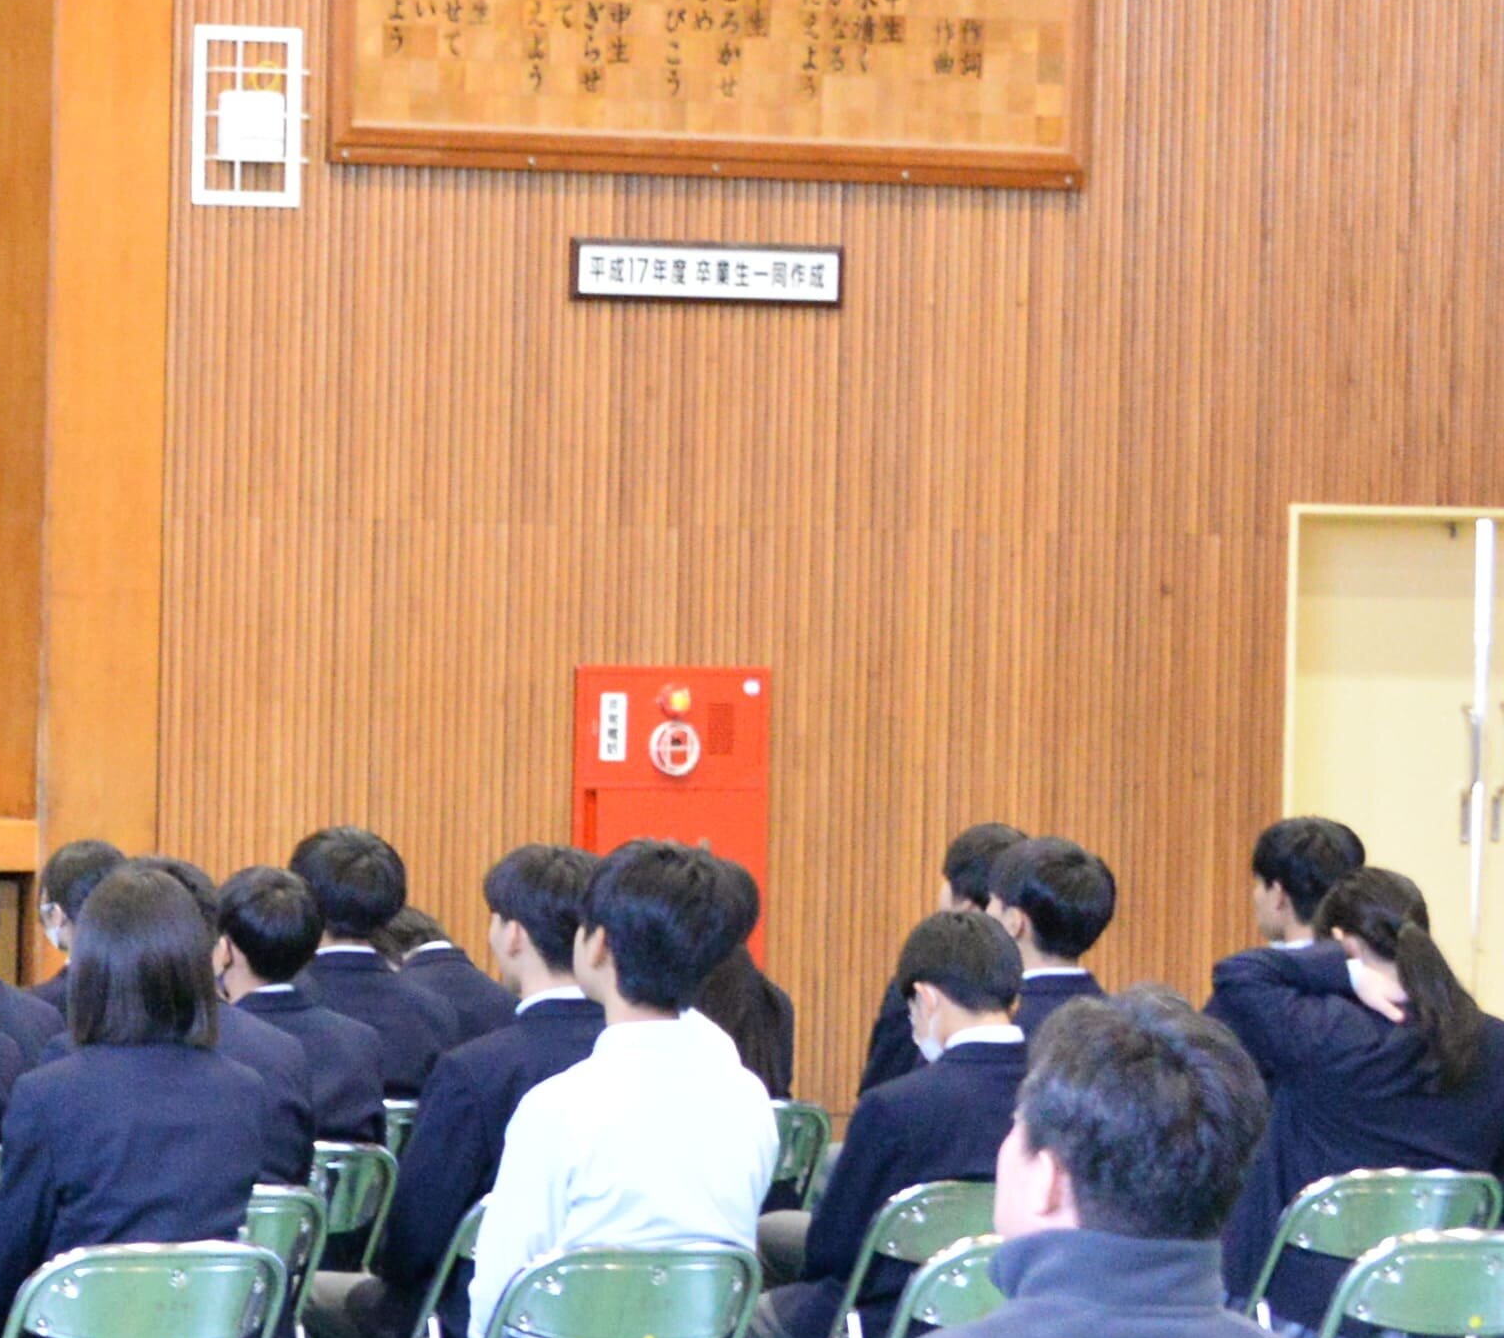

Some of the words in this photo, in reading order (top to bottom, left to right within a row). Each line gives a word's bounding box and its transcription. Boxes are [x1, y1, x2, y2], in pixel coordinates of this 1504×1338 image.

[589, 255, 688, 286] 平成17年度
[695, 258, 826, 289] 卒業生一同作成
